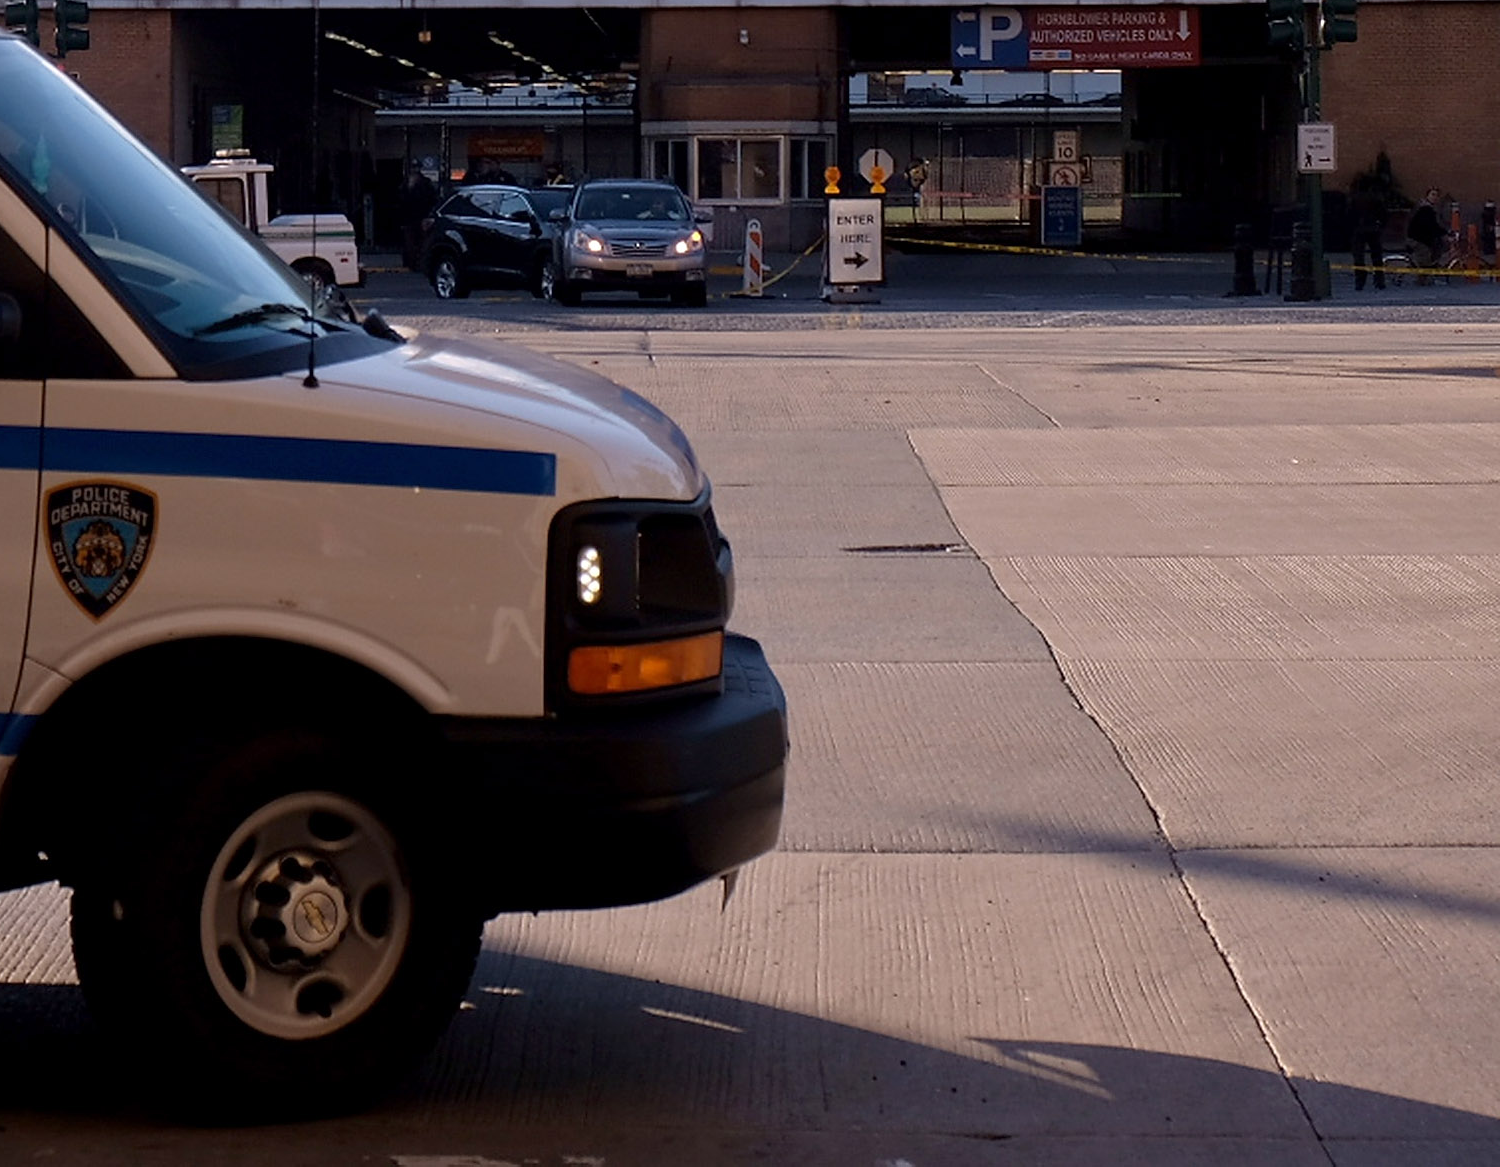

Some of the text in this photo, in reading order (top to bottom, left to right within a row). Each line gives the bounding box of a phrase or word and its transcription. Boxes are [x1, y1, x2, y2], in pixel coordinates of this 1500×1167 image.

[1037, 11, 1167, 26] HORNBLOWER PARKING &
[979, 7, 1023, 61] P
[1030, 29, 1175, 43] AUTHORIZED VEHICLES ONLY
[1058, 147, 1073, 159] 10
[837, 215, 874, 225] ENTER
[72, 487, 130, 505] POLICE
[51, 501, 148, 528] DEPARTMENT
[52, 541, 85, 596] CITY OF
[106, 535, 148, 604] NEW YORK
